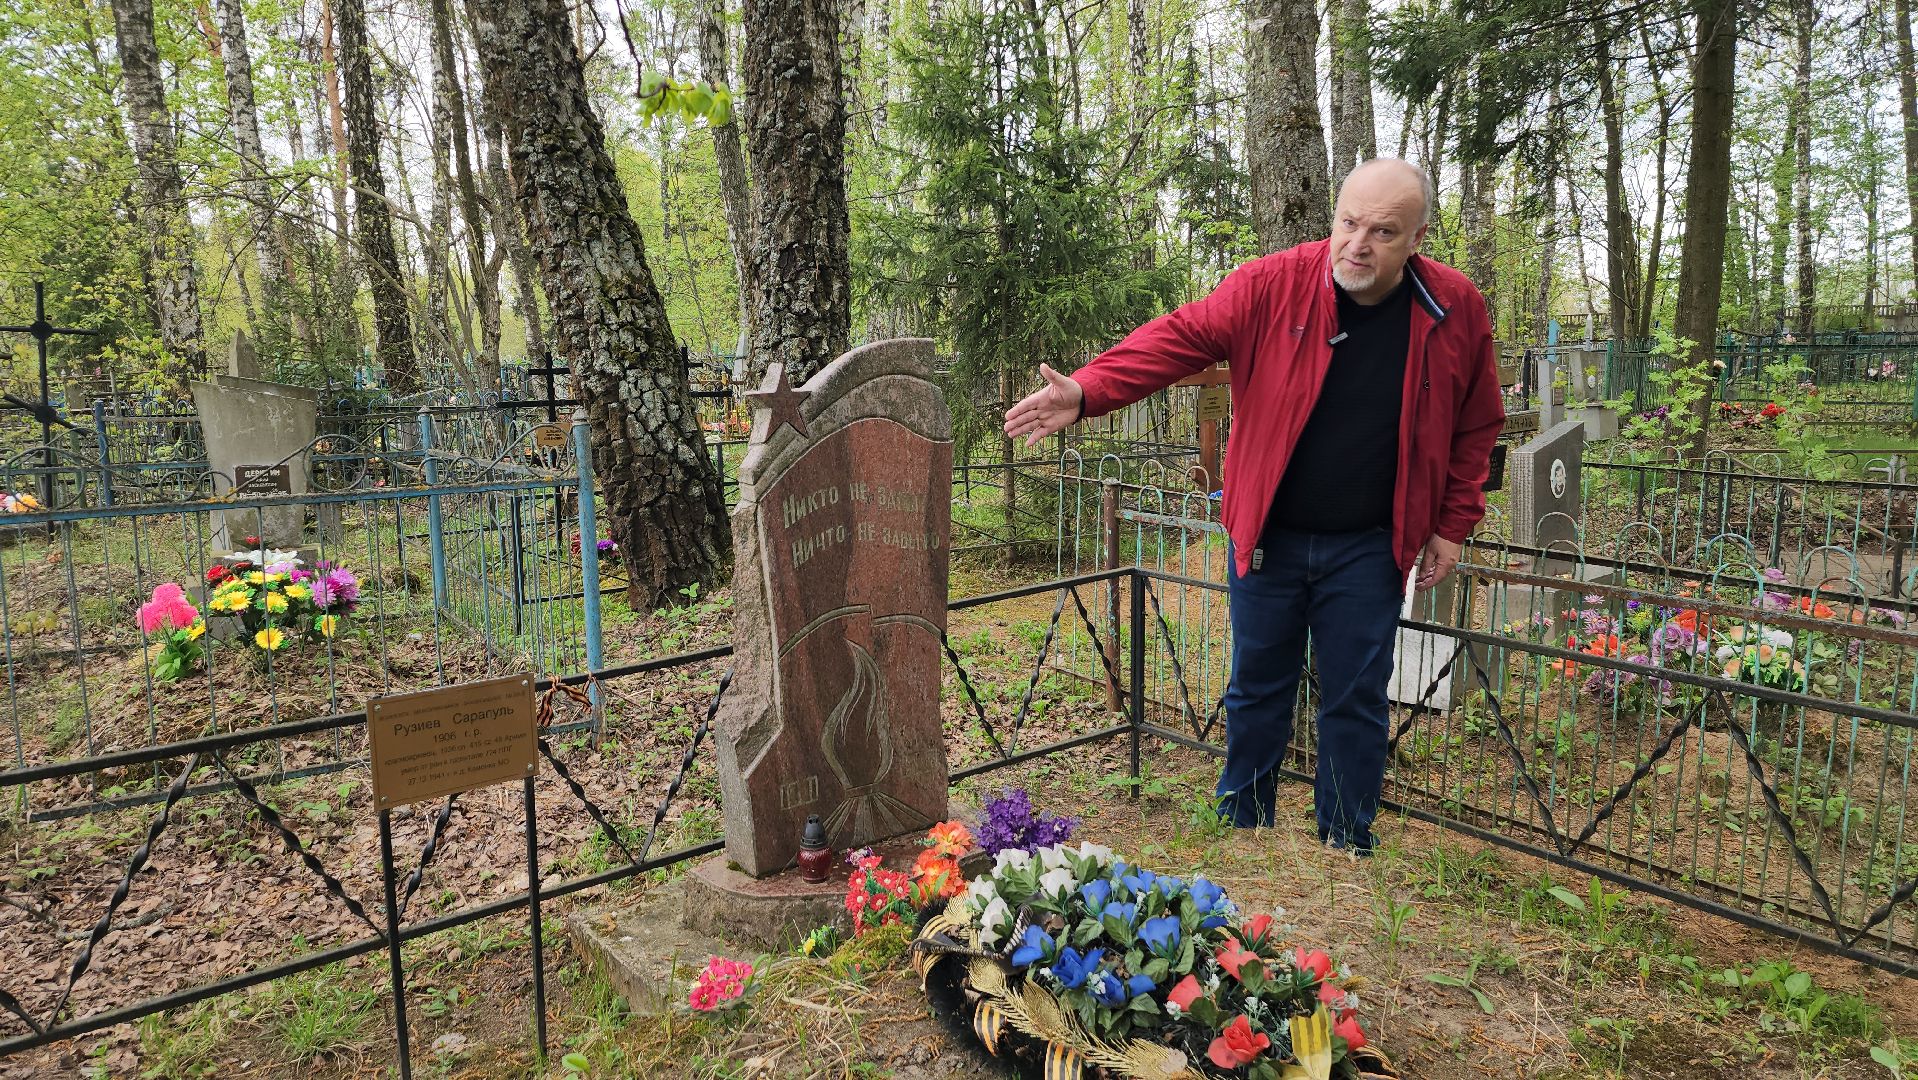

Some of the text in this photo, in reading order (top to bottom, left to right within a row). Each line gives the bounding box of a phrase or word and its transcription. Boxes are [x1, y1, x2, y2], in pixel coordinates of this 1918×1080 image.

[857, 522, 876, 542] НЕ
[393, 719, 441, 737] Рузиев
[452, 706, 514, 725] Сарапуль
